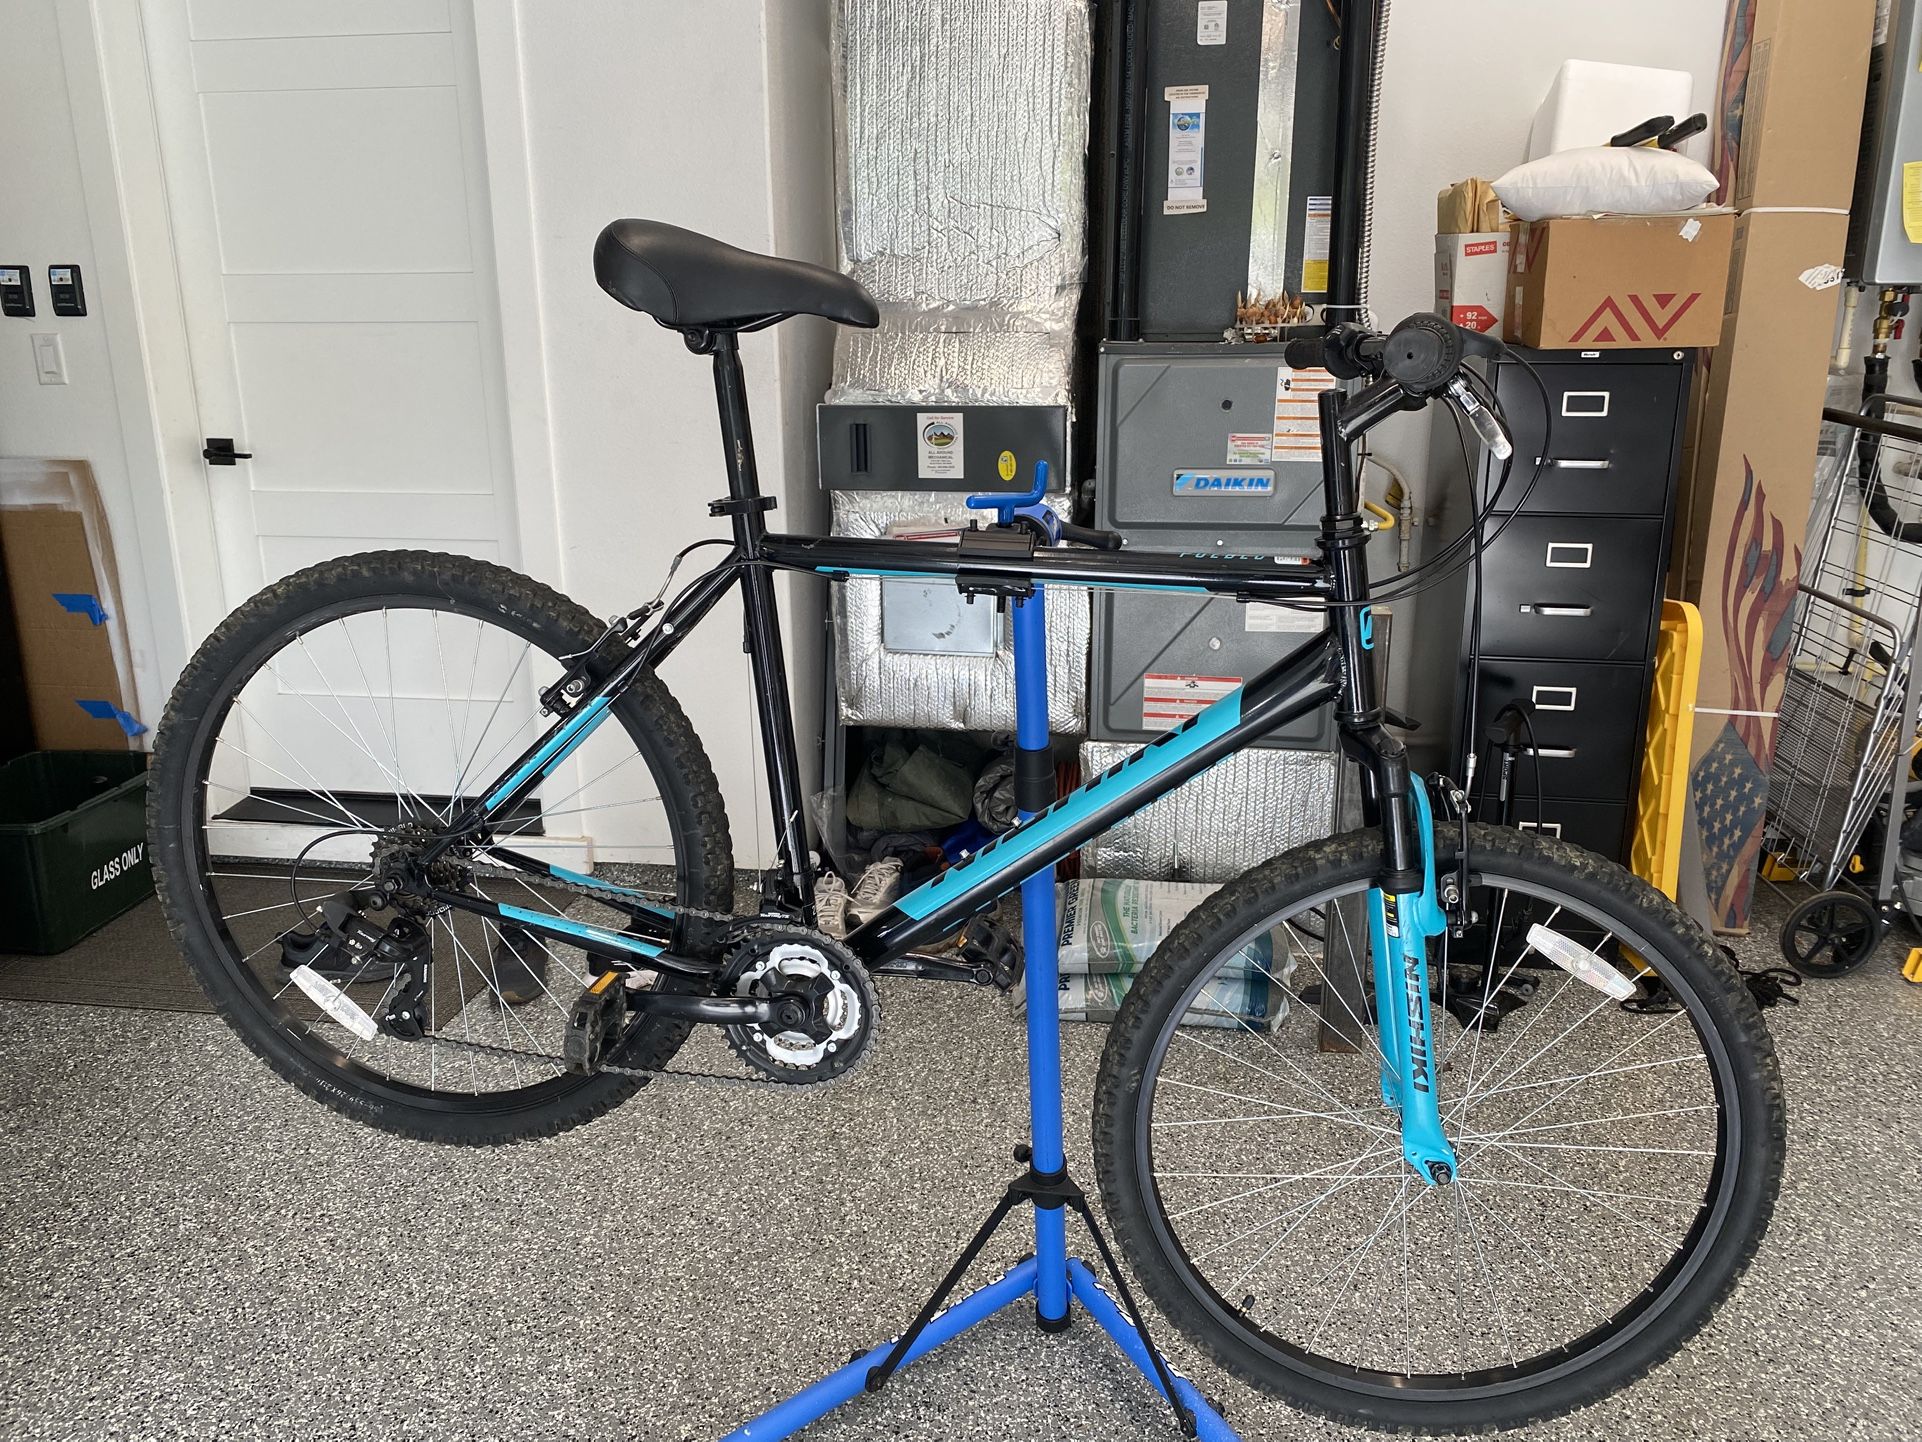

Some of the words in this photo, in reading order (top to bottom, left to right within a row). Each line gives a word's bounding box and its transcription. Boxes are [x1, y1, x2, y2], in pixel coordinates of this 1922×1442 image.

[1466, 244, 1496, 253] STAPLES
[1466, 312, 1478, 320] 92
[1466, 321, 1477, 330] 20
[1193, 476, 1271, 490] DAIKIN
[90, 857, 122, 891] GLASS
[121, 842, 145, 873] ONLY
[1068, 879, 1080, 904] GREEN
[1061, 905, 1077, 946] PREMIER
[1130, 906, 1138, 934] BACTERIA
[1403, 952, 1429, 1094] NISHIKI
